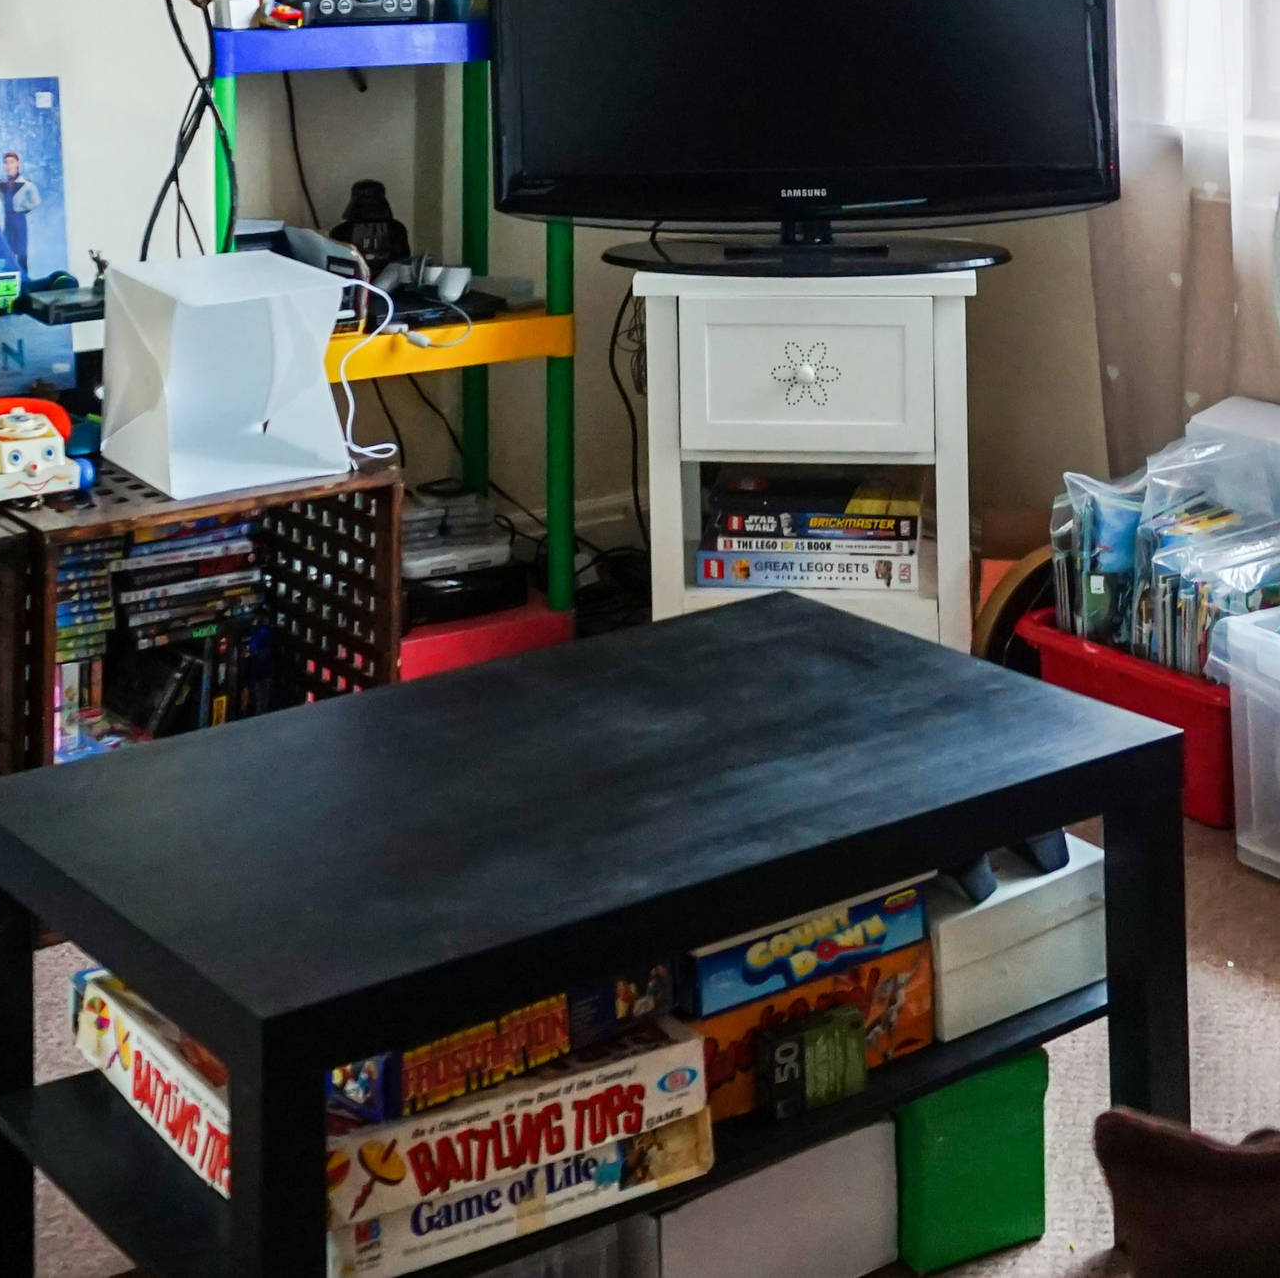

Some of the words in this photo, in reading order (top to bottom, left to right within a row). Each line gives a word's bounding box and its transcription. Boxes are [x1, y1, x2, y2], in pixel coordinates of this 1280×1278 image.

[780, 188, 827, 198] SAMSUNG
[745, 514, 777, 525] STAR
[809, 517, 896, 531] BRICKMASTER
[737, 541, 753, 550] THE
[755, 541, 778, 551] LEGO
[807, 541, 832, 551] BOOK
[754, 561, 795, 572] GREAT
[799, 562, 834, 573] LEGO
[837, 562, 869, 574] SETS
[774, 1041, 799, 1084] 50
[571, 1083, 646, 1151] TOPS
[409, 1186, 503, 1238] Game
[507, 1168, 540, 1206] of
[544, 1152, 599, 1196] Life
